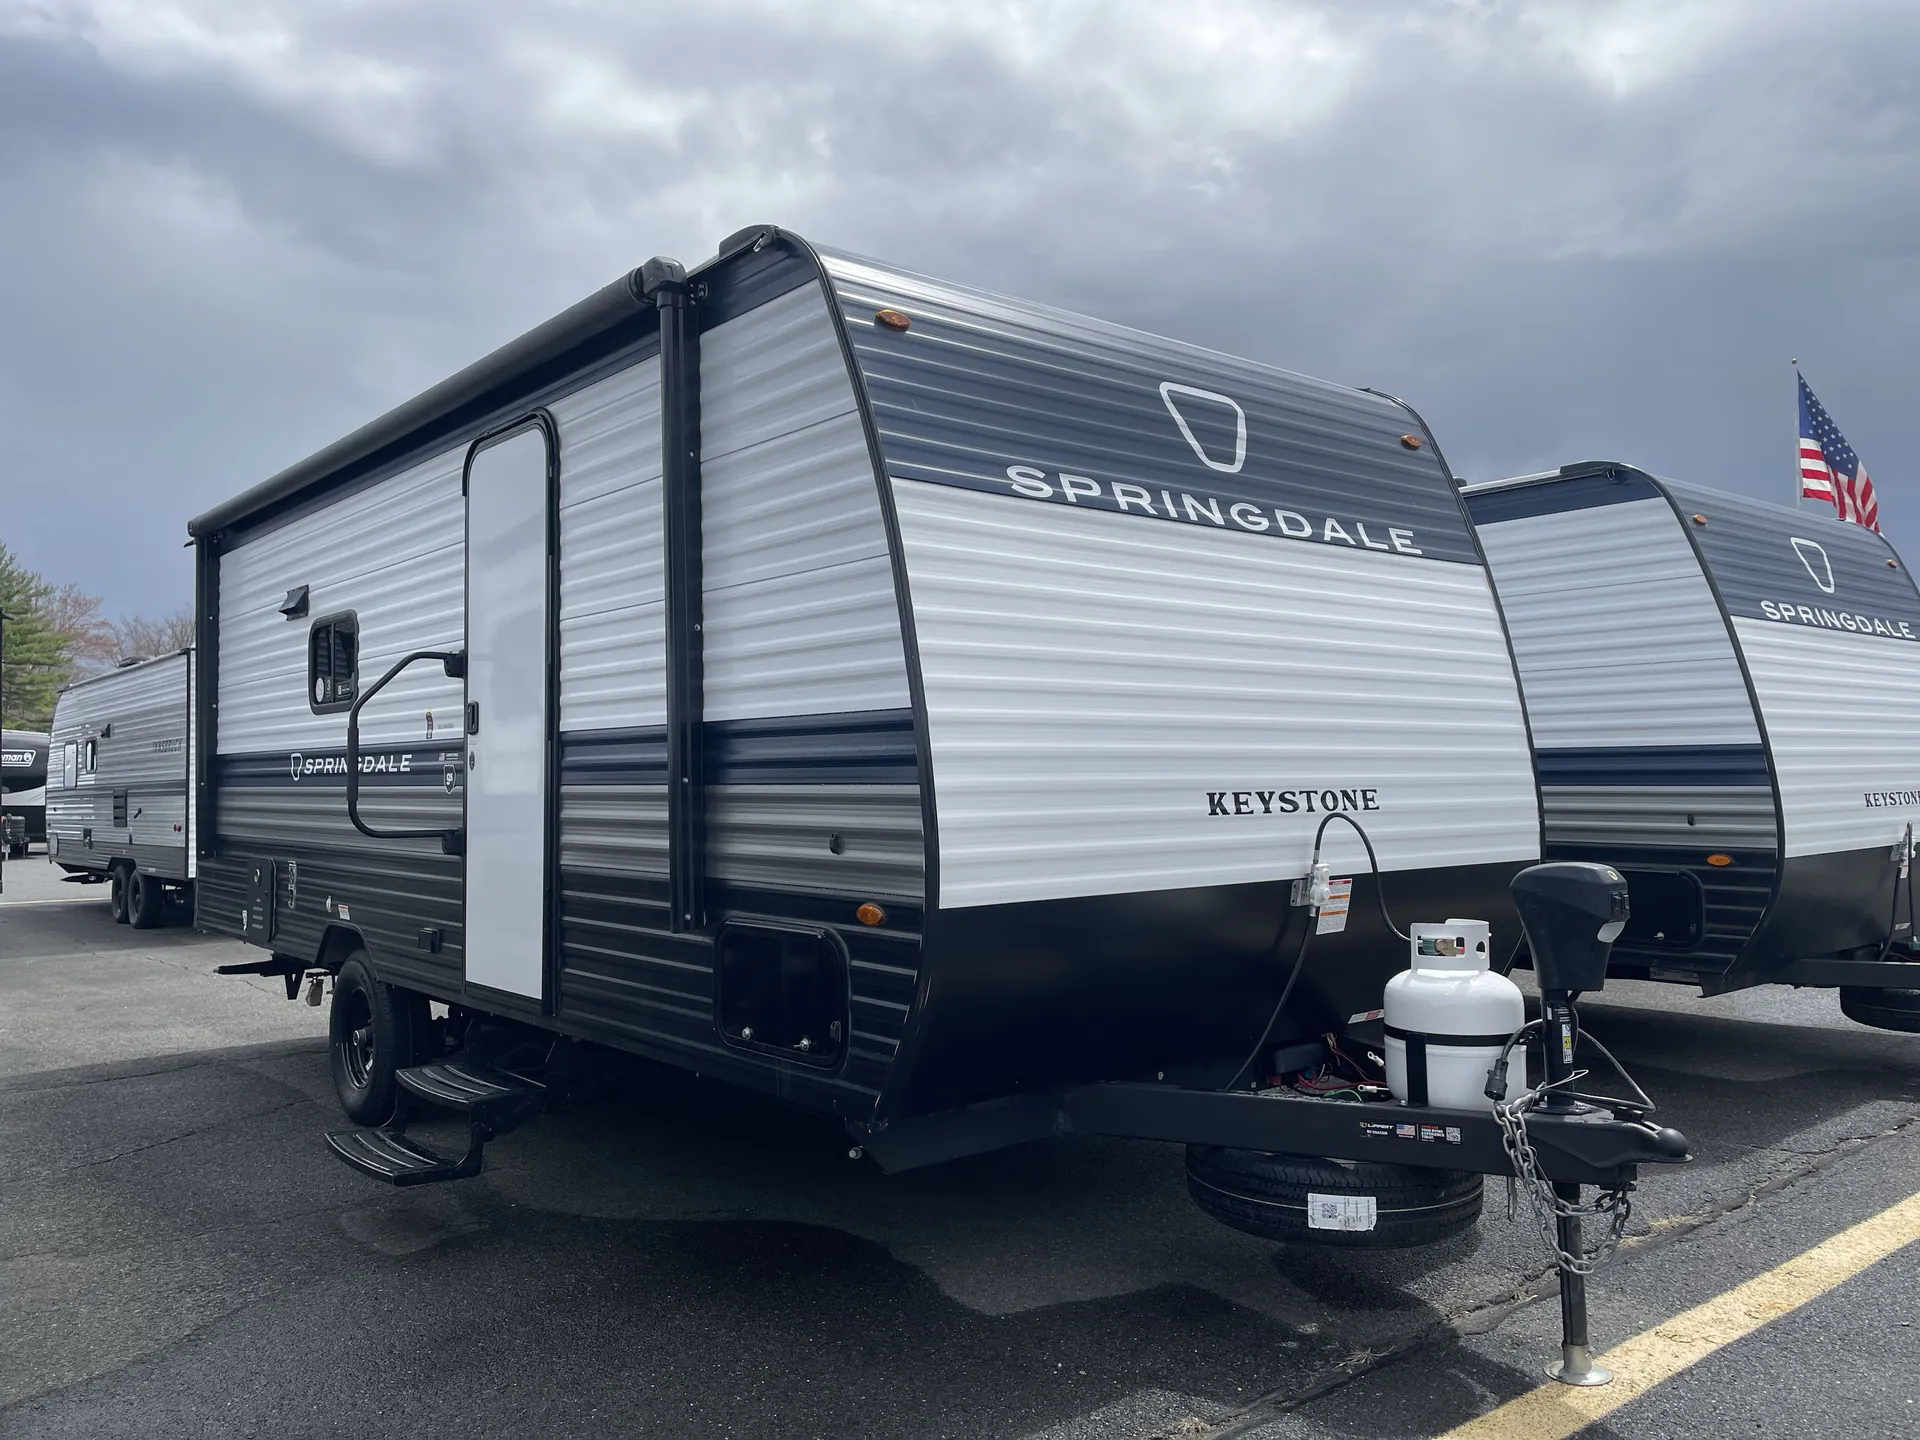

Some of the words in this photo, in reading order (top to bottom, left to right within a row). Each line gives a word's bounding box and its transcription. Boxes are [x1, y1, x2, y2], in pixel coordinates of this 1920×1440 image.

[1006, 465, 1423, 555] SPRINGDALE
[1760, 600, 1916, 639] SPRINGDALE
[1206, 788, 1380, 816] KEYSTONE
